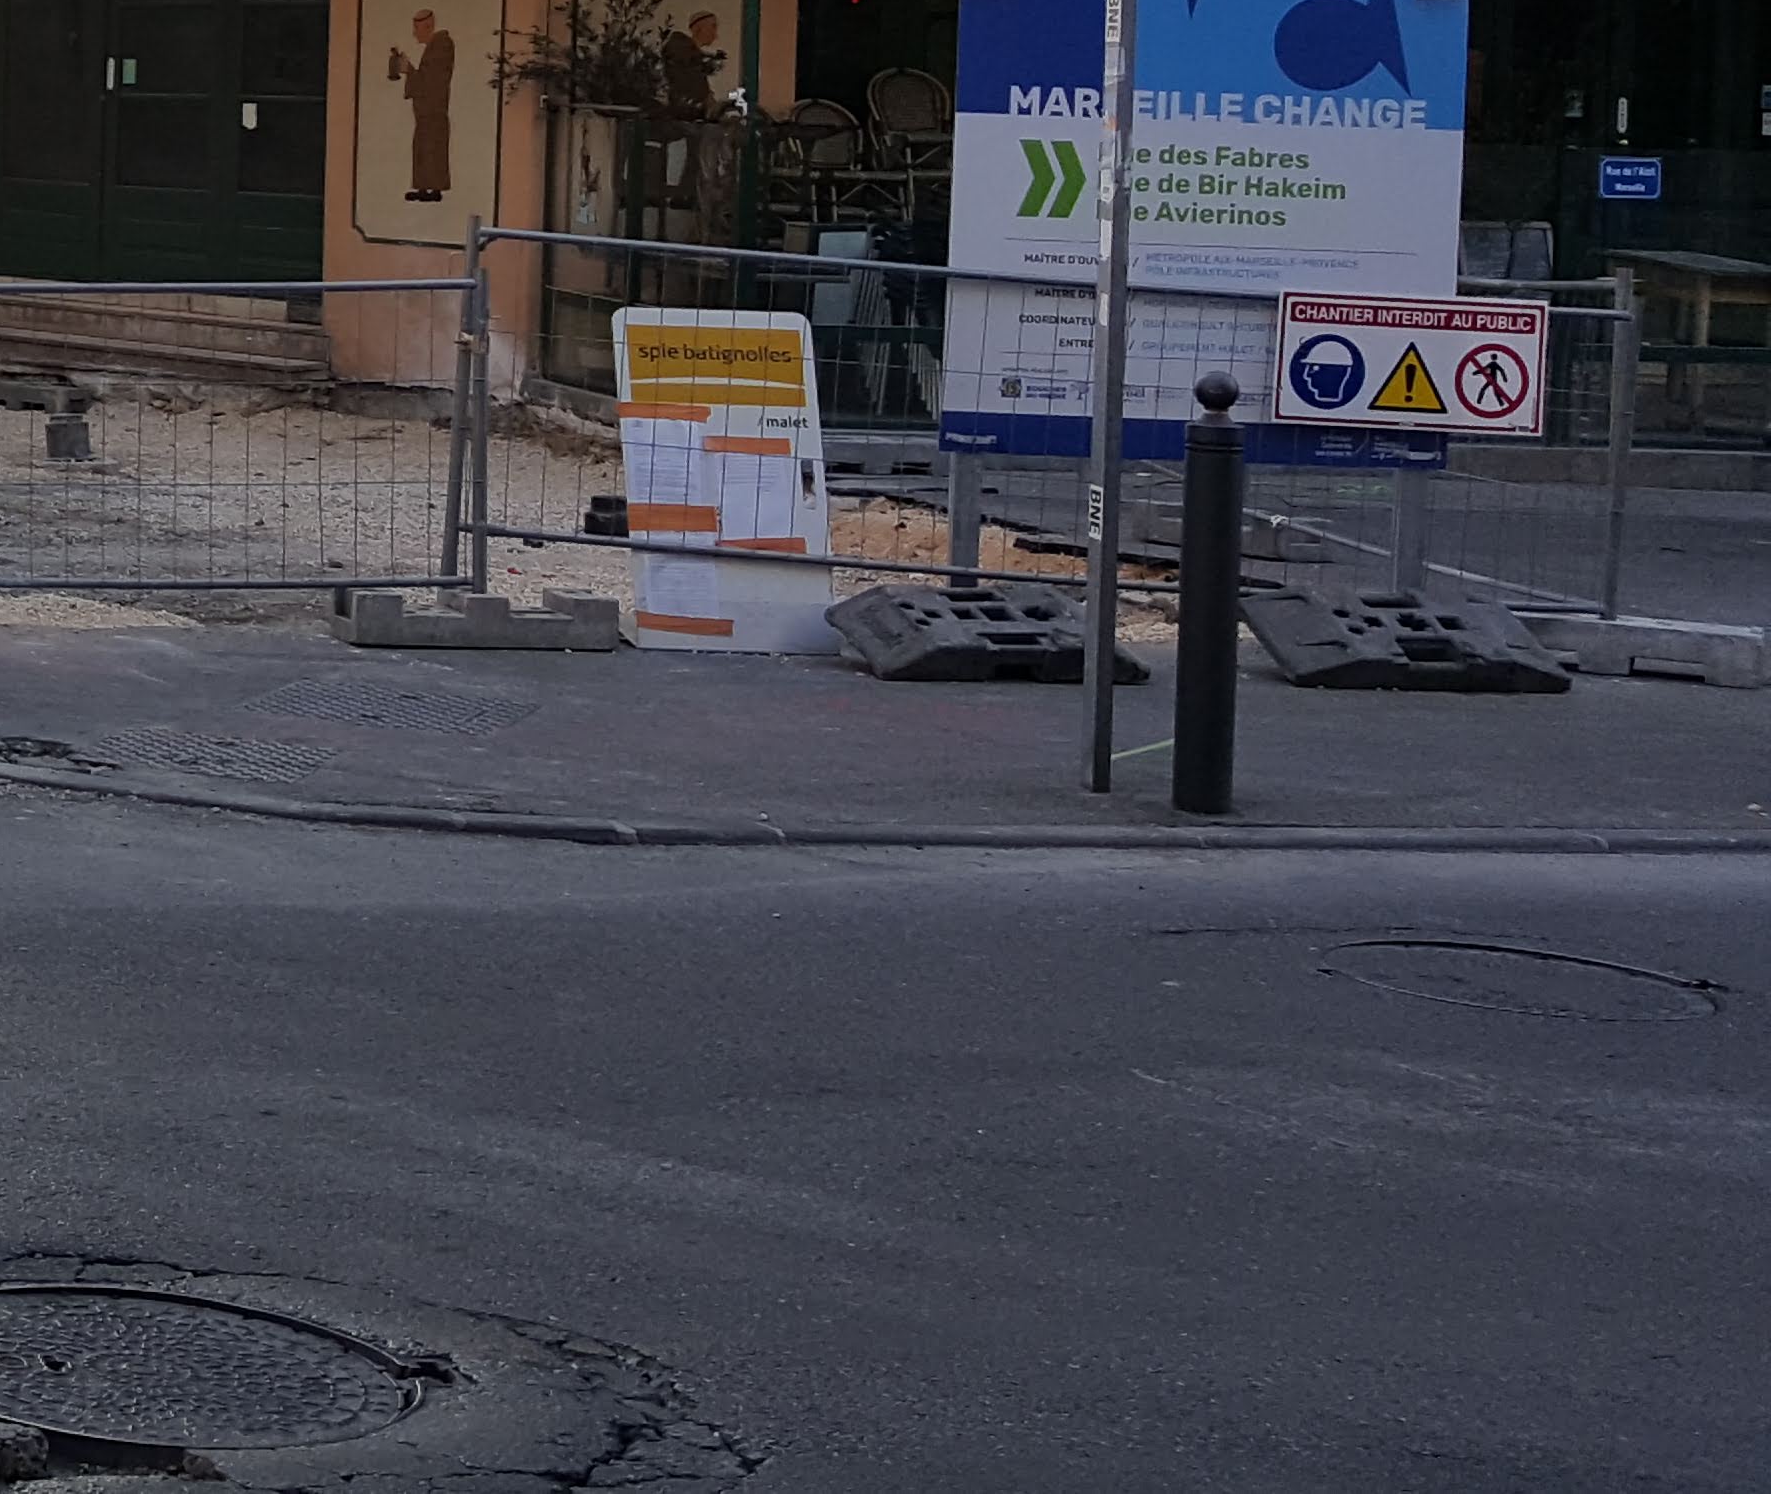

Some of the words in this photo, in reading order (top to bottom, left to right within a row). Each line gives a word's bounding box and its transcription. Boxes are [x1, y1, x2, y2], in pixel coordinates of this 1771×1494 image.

[1008, 84, 1245, 124] MAREILLE
[1254, 94, 1428, 131] CHANGE
[1158, 144, 1208, 166] des
[1215, 146, 1310, 170] Fabres
[1158, 174, 1191, 195] de
[1199, 174, 1238, 197] Bir
[1244, 176, 1347, 200] Hakeim
[1154, 203, 1287, 227] Avierinos
[1019, 314, 1097, 326] COORDINATEU
[1294, 305, 1374, 322] CHANTIER
[1377, 308, 1447, 327] INTERDIT
[1450, 312, 1472, 328] AU
[1476, 314, 1533, 332] PUBLIC
[638, 342, 680, 363] spie
[683, 343, 792, 365] batignolles
[766, 415, 809, 430] malet
[1089, 489, 1102, 536] BNE
